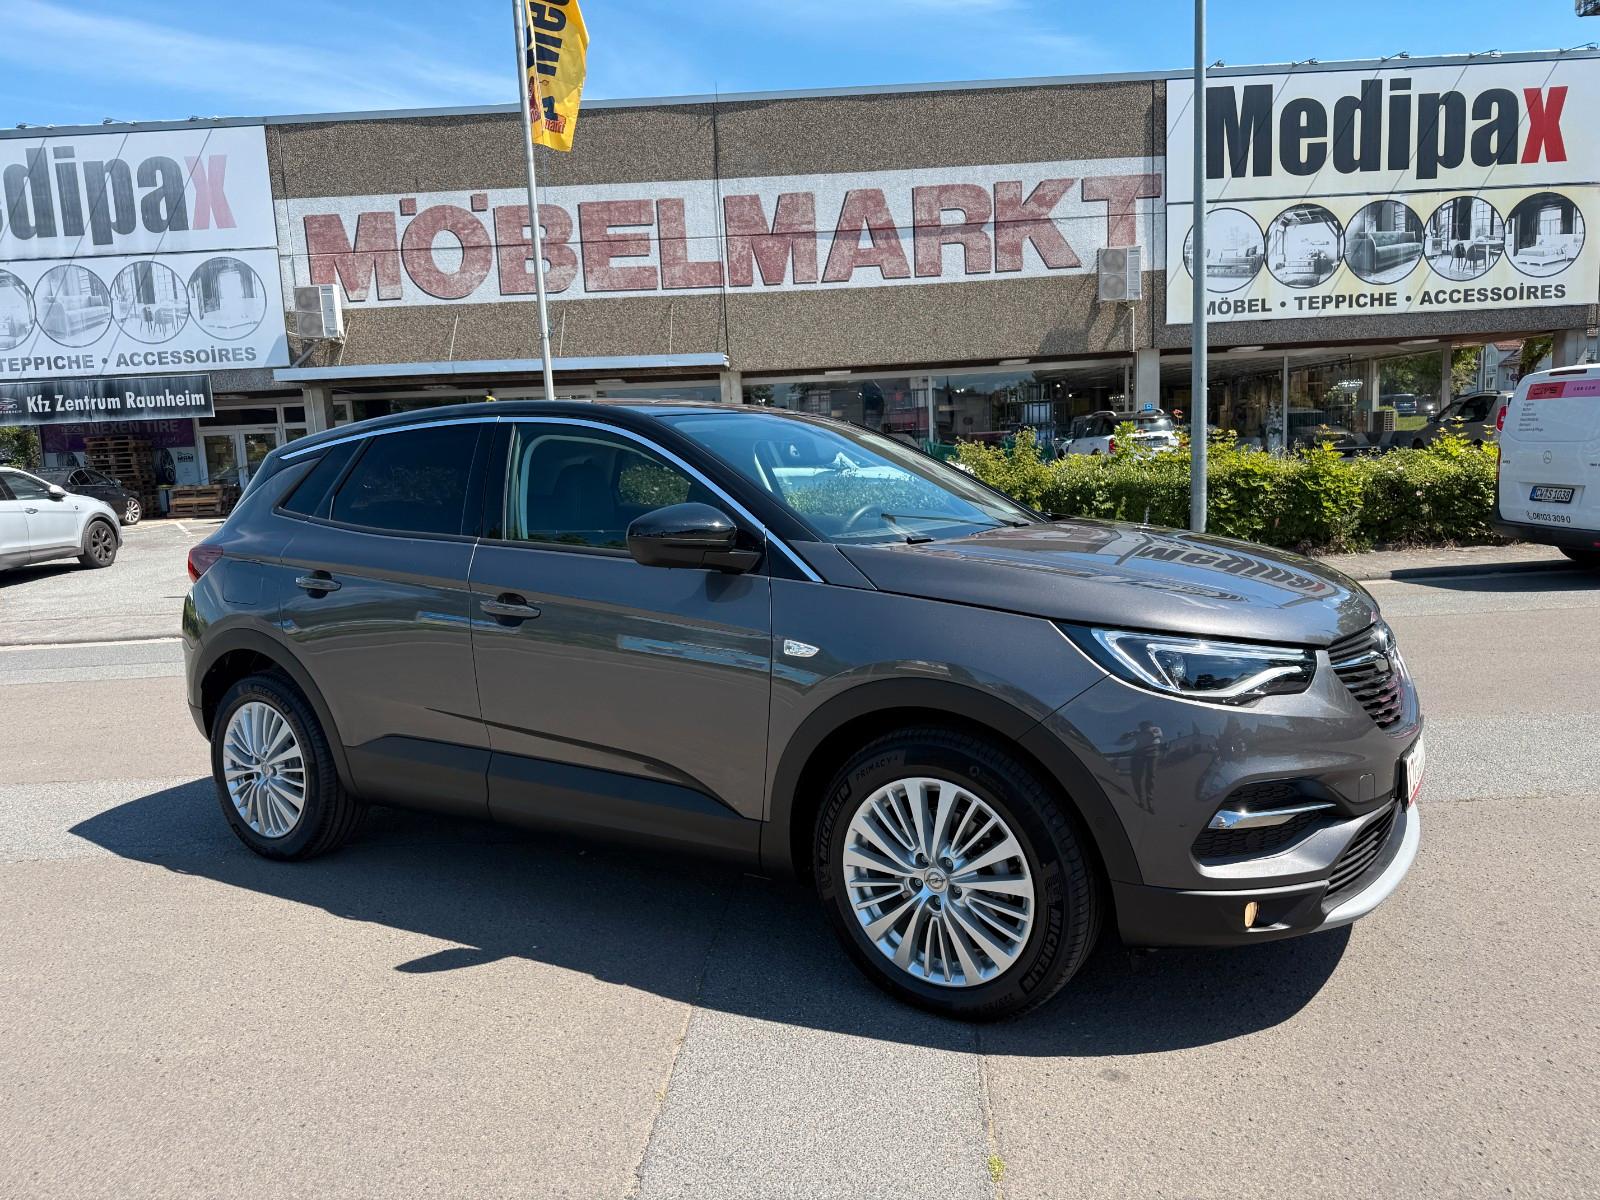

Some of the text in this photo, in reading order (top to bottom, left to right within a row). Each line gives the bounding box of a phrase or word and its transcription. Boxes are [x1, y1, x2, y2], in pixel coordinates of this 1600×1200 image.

[1206, 77, 1568, 180] Medipax
[0, 146, 237, 246] dipax
[303, 173, 1162, 302] MÖBELMARKT
[1294, 291, 1397, 311] TEPPICHE
[0, 354, 95, 372] TEPPICHE
[26, 388, 205, 413] Kfz Zentrum Raunheim
[89, 422, 140, 434] NEXEN
[142, 420, 179, 433] TIRE
